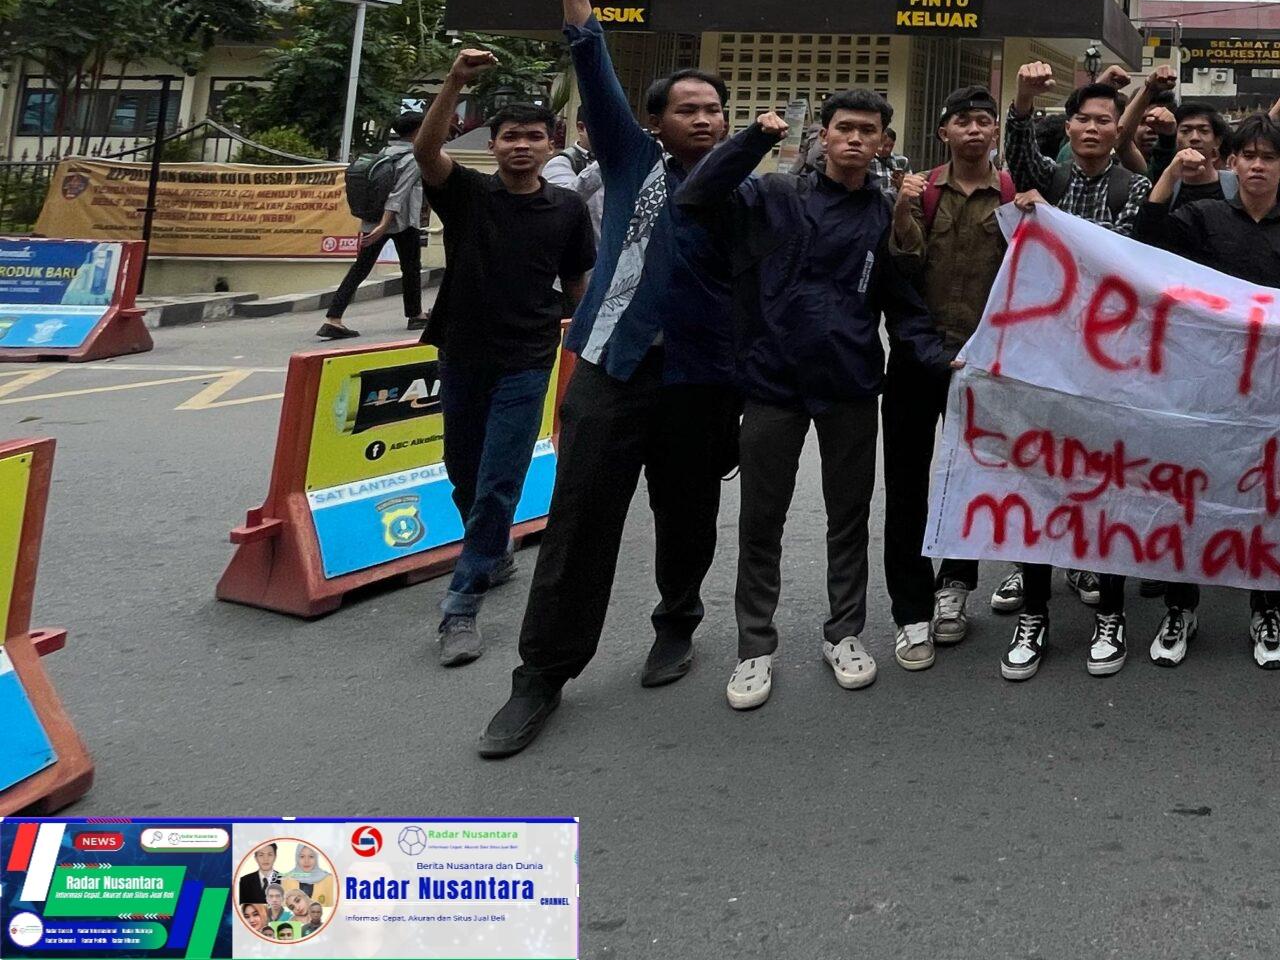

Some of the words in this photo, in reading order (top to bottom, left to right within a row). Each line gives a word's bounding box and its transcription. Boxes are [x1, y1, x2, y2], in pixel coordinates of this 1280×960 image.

[592, 7, 646, 23] ASUK
[896, 10, 978, 28] KELUAR
[1210, 40, 1269, 49] SELAMAT
[1190, 49, 1204, 58] DI
[254, 172, 292, 185] BESAR
[45, 266, 82, 279] BARU
[963, 385, 1209, 527] tangkap
[315, 488, 343, 503] SAT
[349, 474, 407, 495] LANTAS
